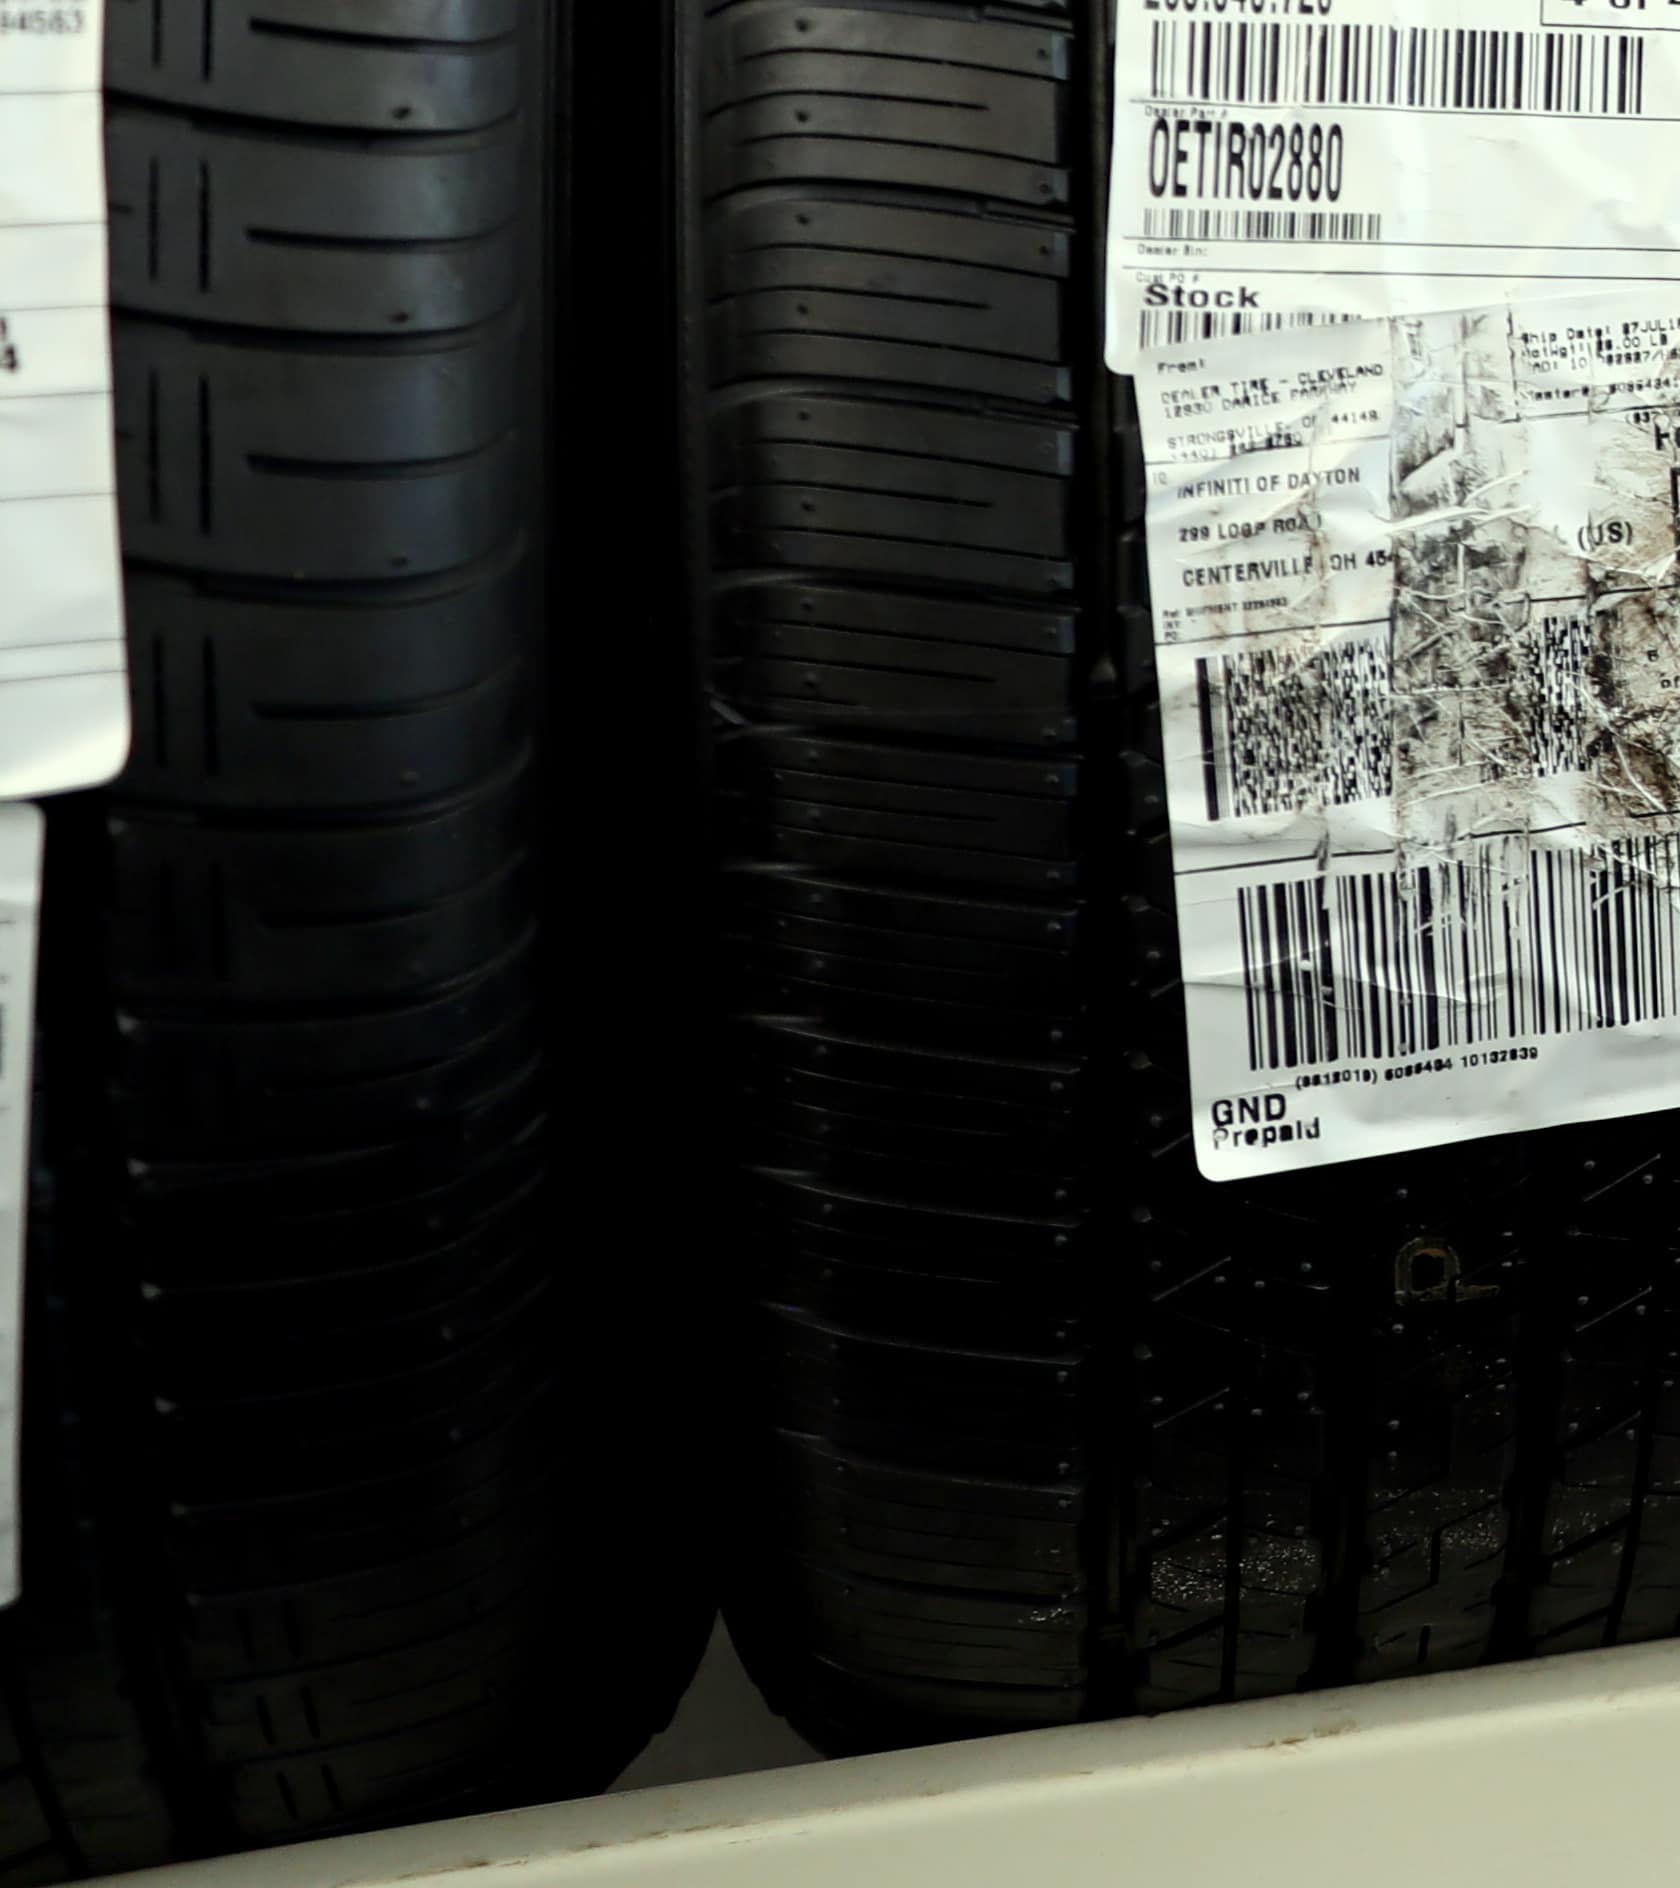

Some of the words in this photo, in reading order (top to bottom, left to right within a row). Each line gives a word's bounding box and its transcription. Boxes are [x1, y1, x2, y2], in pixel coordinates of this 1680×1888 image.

[1149, 115, 1344, 202] OETIR02880
[1143, 283, 1261, 310] Stock
[1297, 363, 1384, 386] CLEVELAND
[1176, 481, 1251, 500] INFINITI
[1256, 474, 1280, 493] OF
[1287, 466, 1361, 490] DAYTON
[1577, 520, 1634, 552] (US)
[1181, 555, 1314, 589] CENTERVILLE
[1211, 1092, 1287, 1127] GND
[1212, 1117, 1321, 1150] Prepaid
